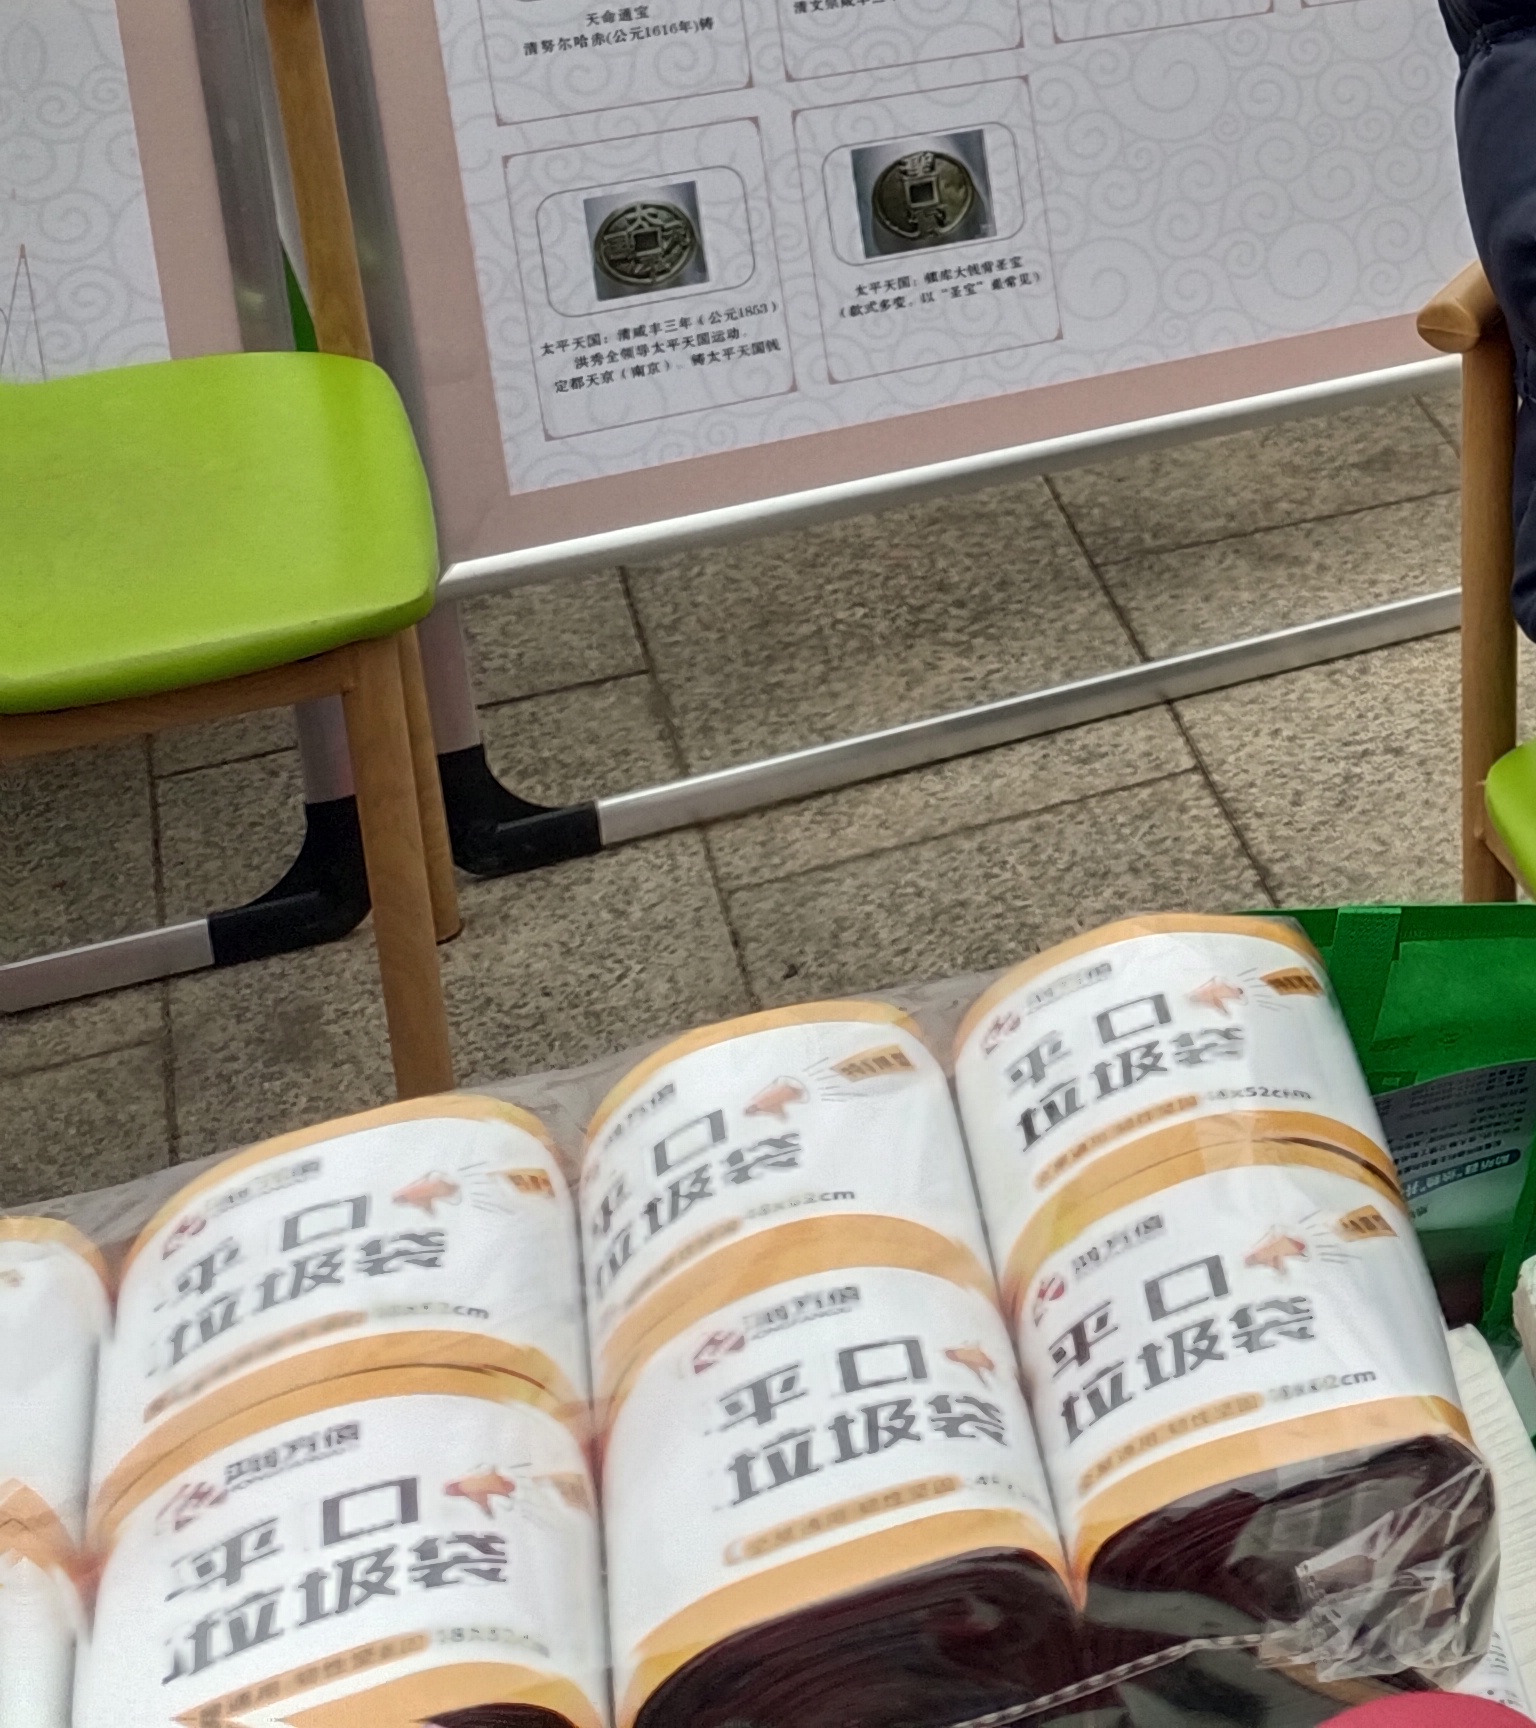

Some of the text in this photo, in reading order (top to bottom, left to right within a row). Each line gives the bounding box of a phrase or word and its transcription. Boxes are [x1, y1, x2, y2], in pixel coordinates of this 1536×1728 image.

[586, 5, 649, 27] 天命通宝
[1007, 993, 1173, 1097] 平口
[1017, 1027, 1245, 1152] 垃圾袋
[595, 1109, 727, 1234] 平口
[597, 1133, 802, 1296] 垃圾袋
[147, 1230, 447, 1376] 垃圾袋
[154, 1195, 370, 1313] 平口
[1048, 1254, 1229, 1380] 平口
[1061, 1295, 1316, 1445] 垃圾袋
[704, 1337, 928, 1437] 平口
[712, 1395, 1008, 1510] 垃圾袋
[165, 1477, 420, 1602] 平口
[162, 1532, 508, 1685] 垃圾袋
